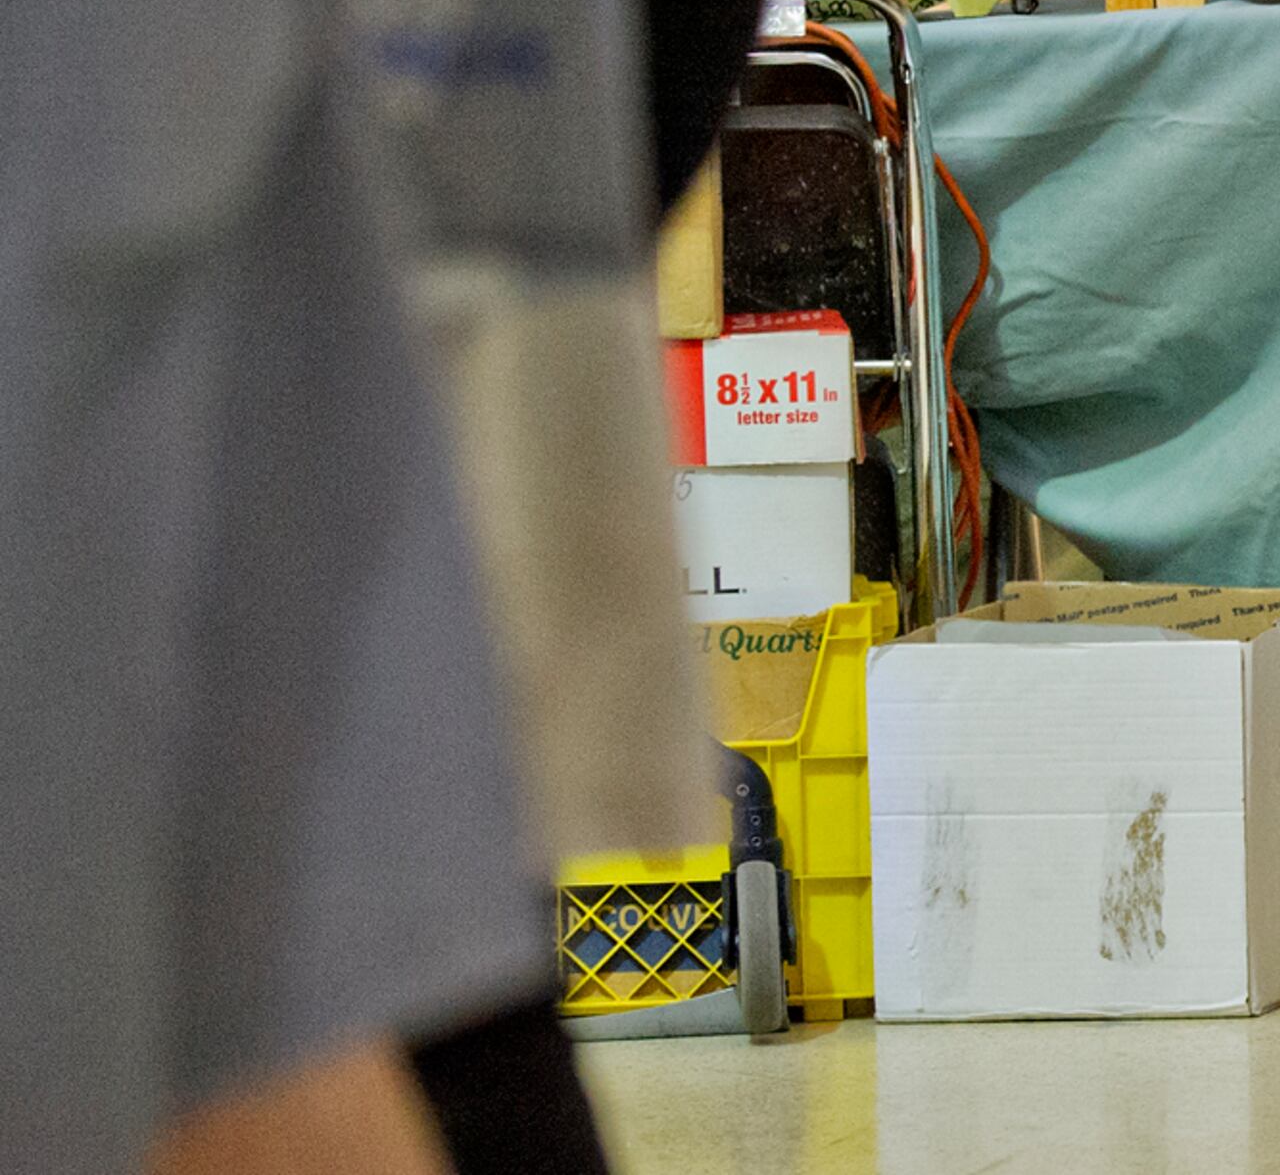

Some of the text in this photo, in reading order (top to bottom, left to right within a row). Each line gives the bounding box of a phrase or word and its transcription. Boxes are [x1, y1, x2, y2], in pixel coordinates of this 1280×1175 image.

[783, 370, 817, 403] 11
[823, 388, 838, 402] in
[737, 409, 819, 425] letter size
[1087, 601, 1130, 619] postage
[1132, 593, 1178, 609] required
[1176, 615, 1222, 631] required
[1231, 603, 1265, 617] Thank
